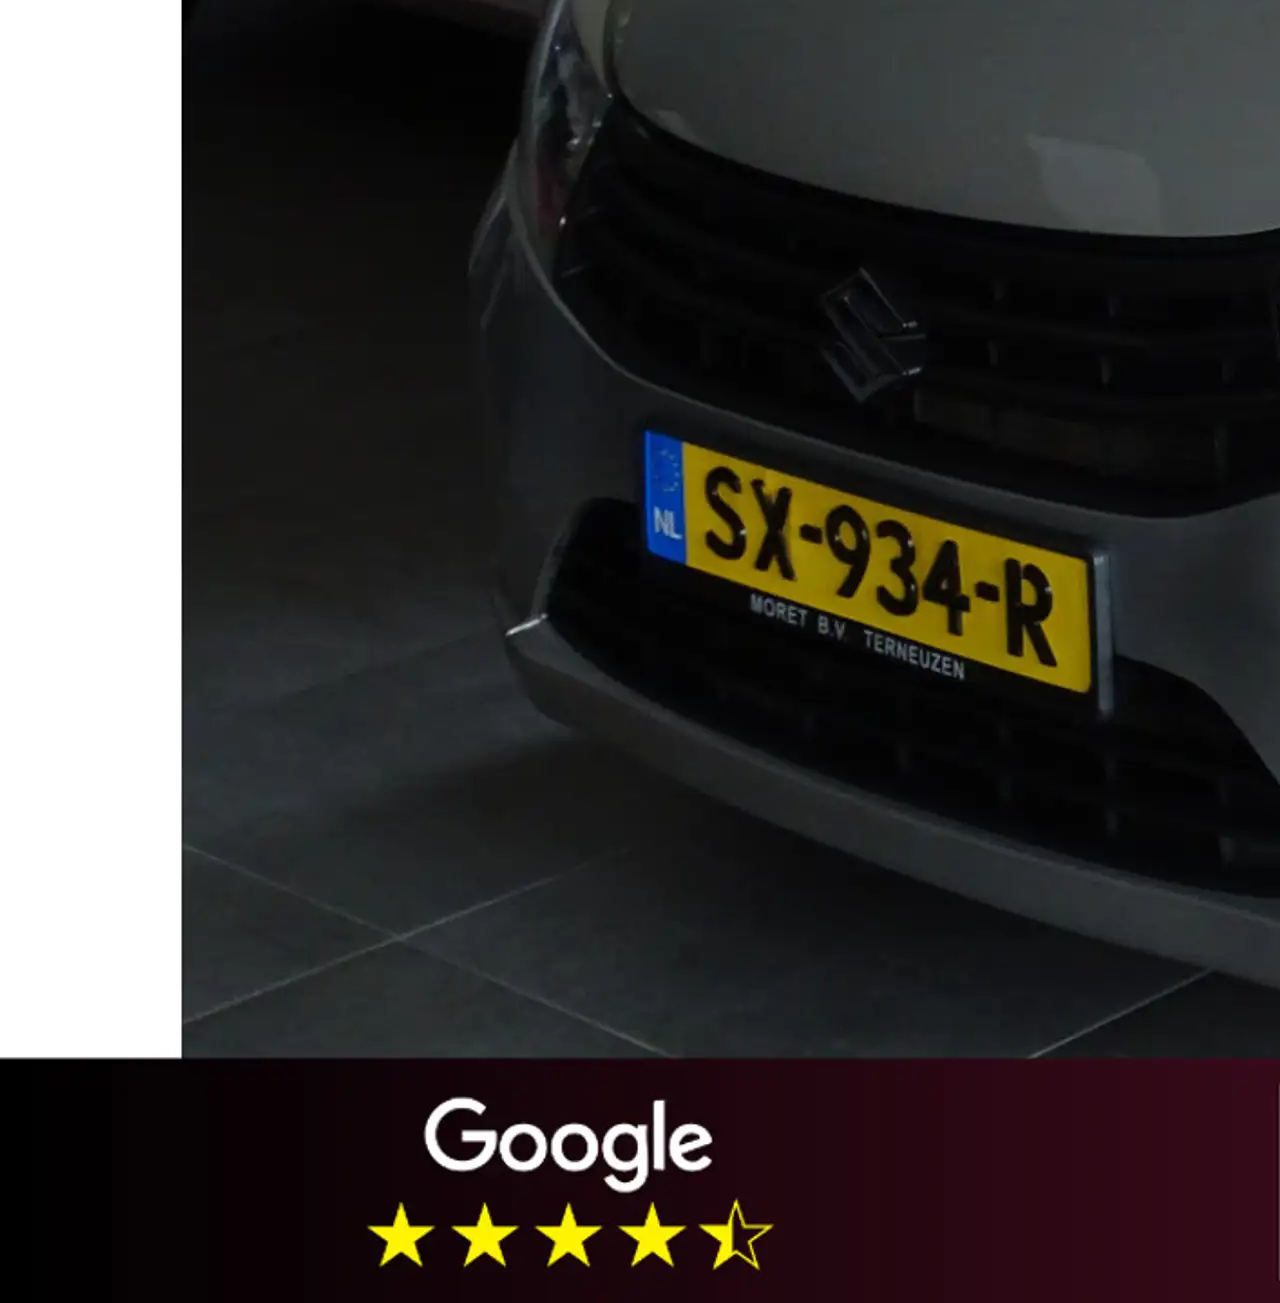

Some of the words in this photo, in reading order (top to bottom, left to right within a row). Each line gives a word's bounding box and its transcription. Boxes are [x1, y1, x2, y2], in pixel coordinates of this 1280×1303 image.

[653, 506, 683, 541] NL
[705, 466, 1058, 668] SX-934-R
[750, 593, 808, 628] MORET
[863, 629, 966, 681] TERNEUZEN
